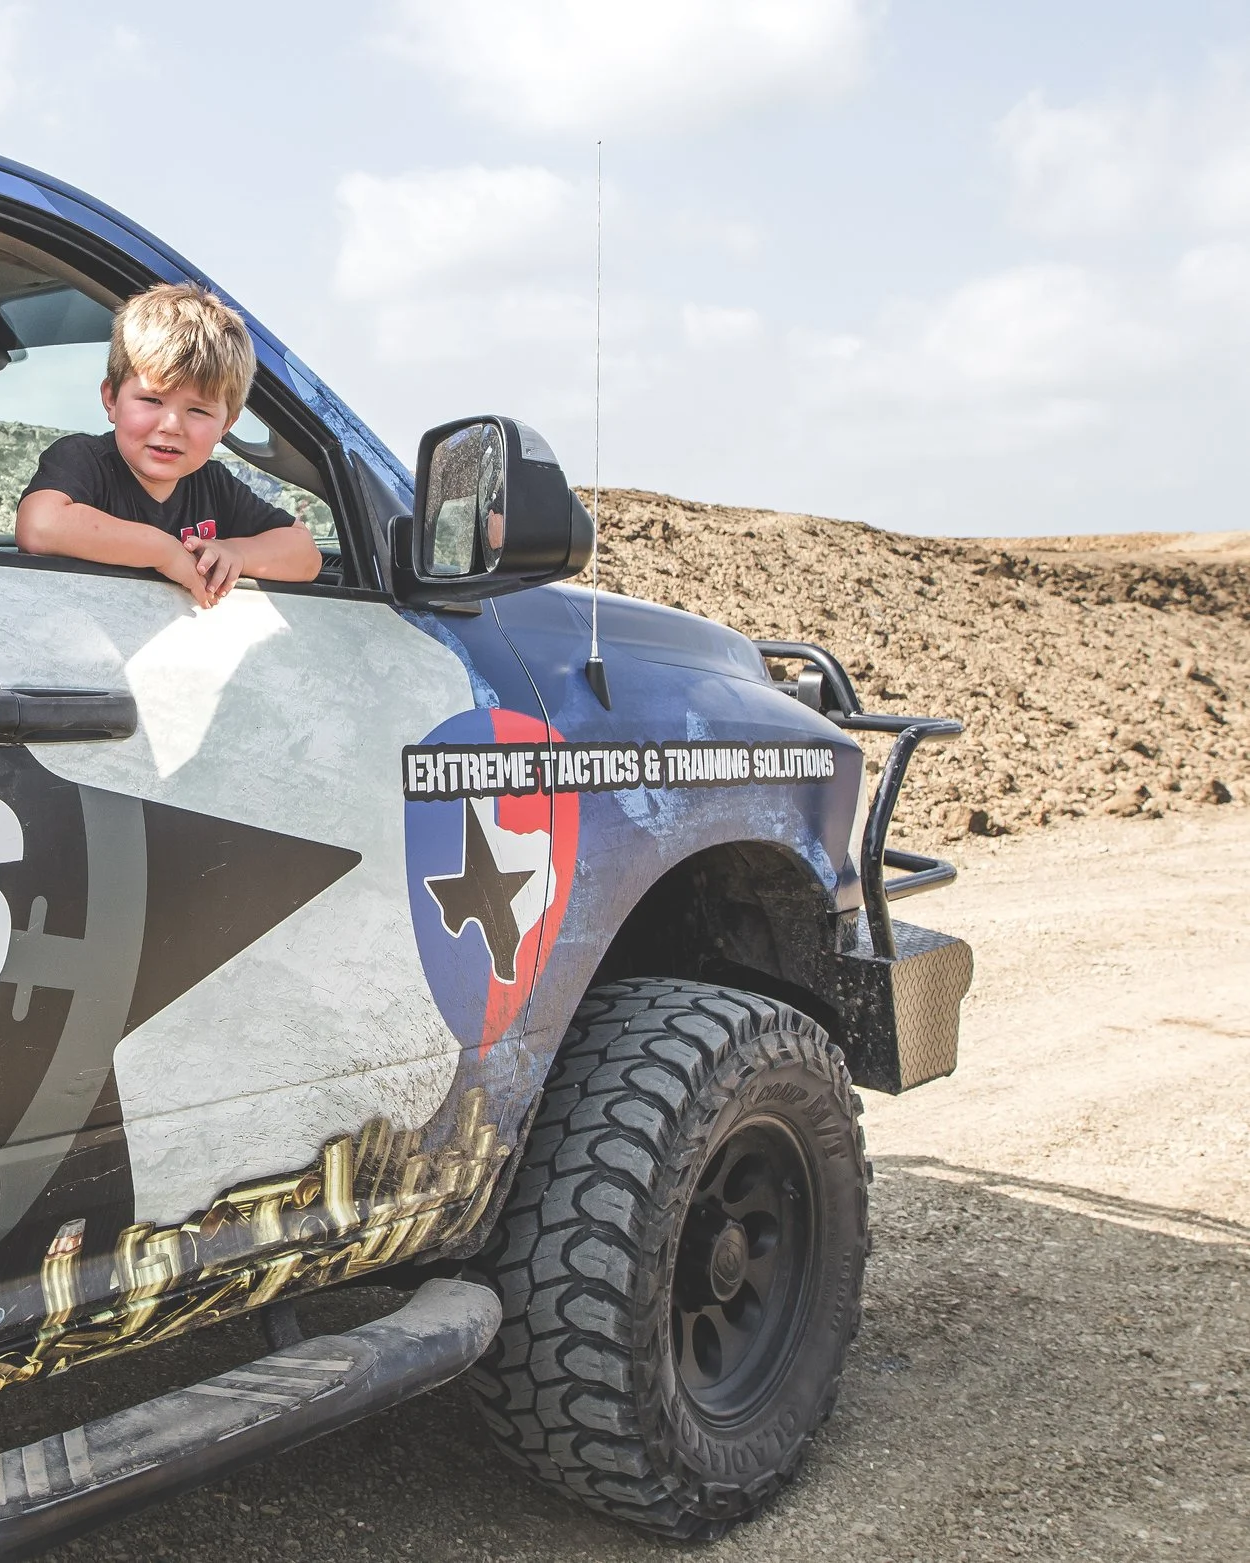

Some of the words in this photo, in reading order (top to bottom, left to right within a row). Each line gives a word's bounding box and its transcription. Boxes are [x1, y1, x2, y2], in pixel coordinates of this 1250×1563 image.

[406, 750, 535, 794] EXTREME
[539, 748, 640, 787] TACTICS
[643, 749, 662, 782] &
[664, 748, 750, 782] TRAINING
[752, 747, 836, 778] SOLUTIONS
[803, 1094, 848, 1159] M/T
